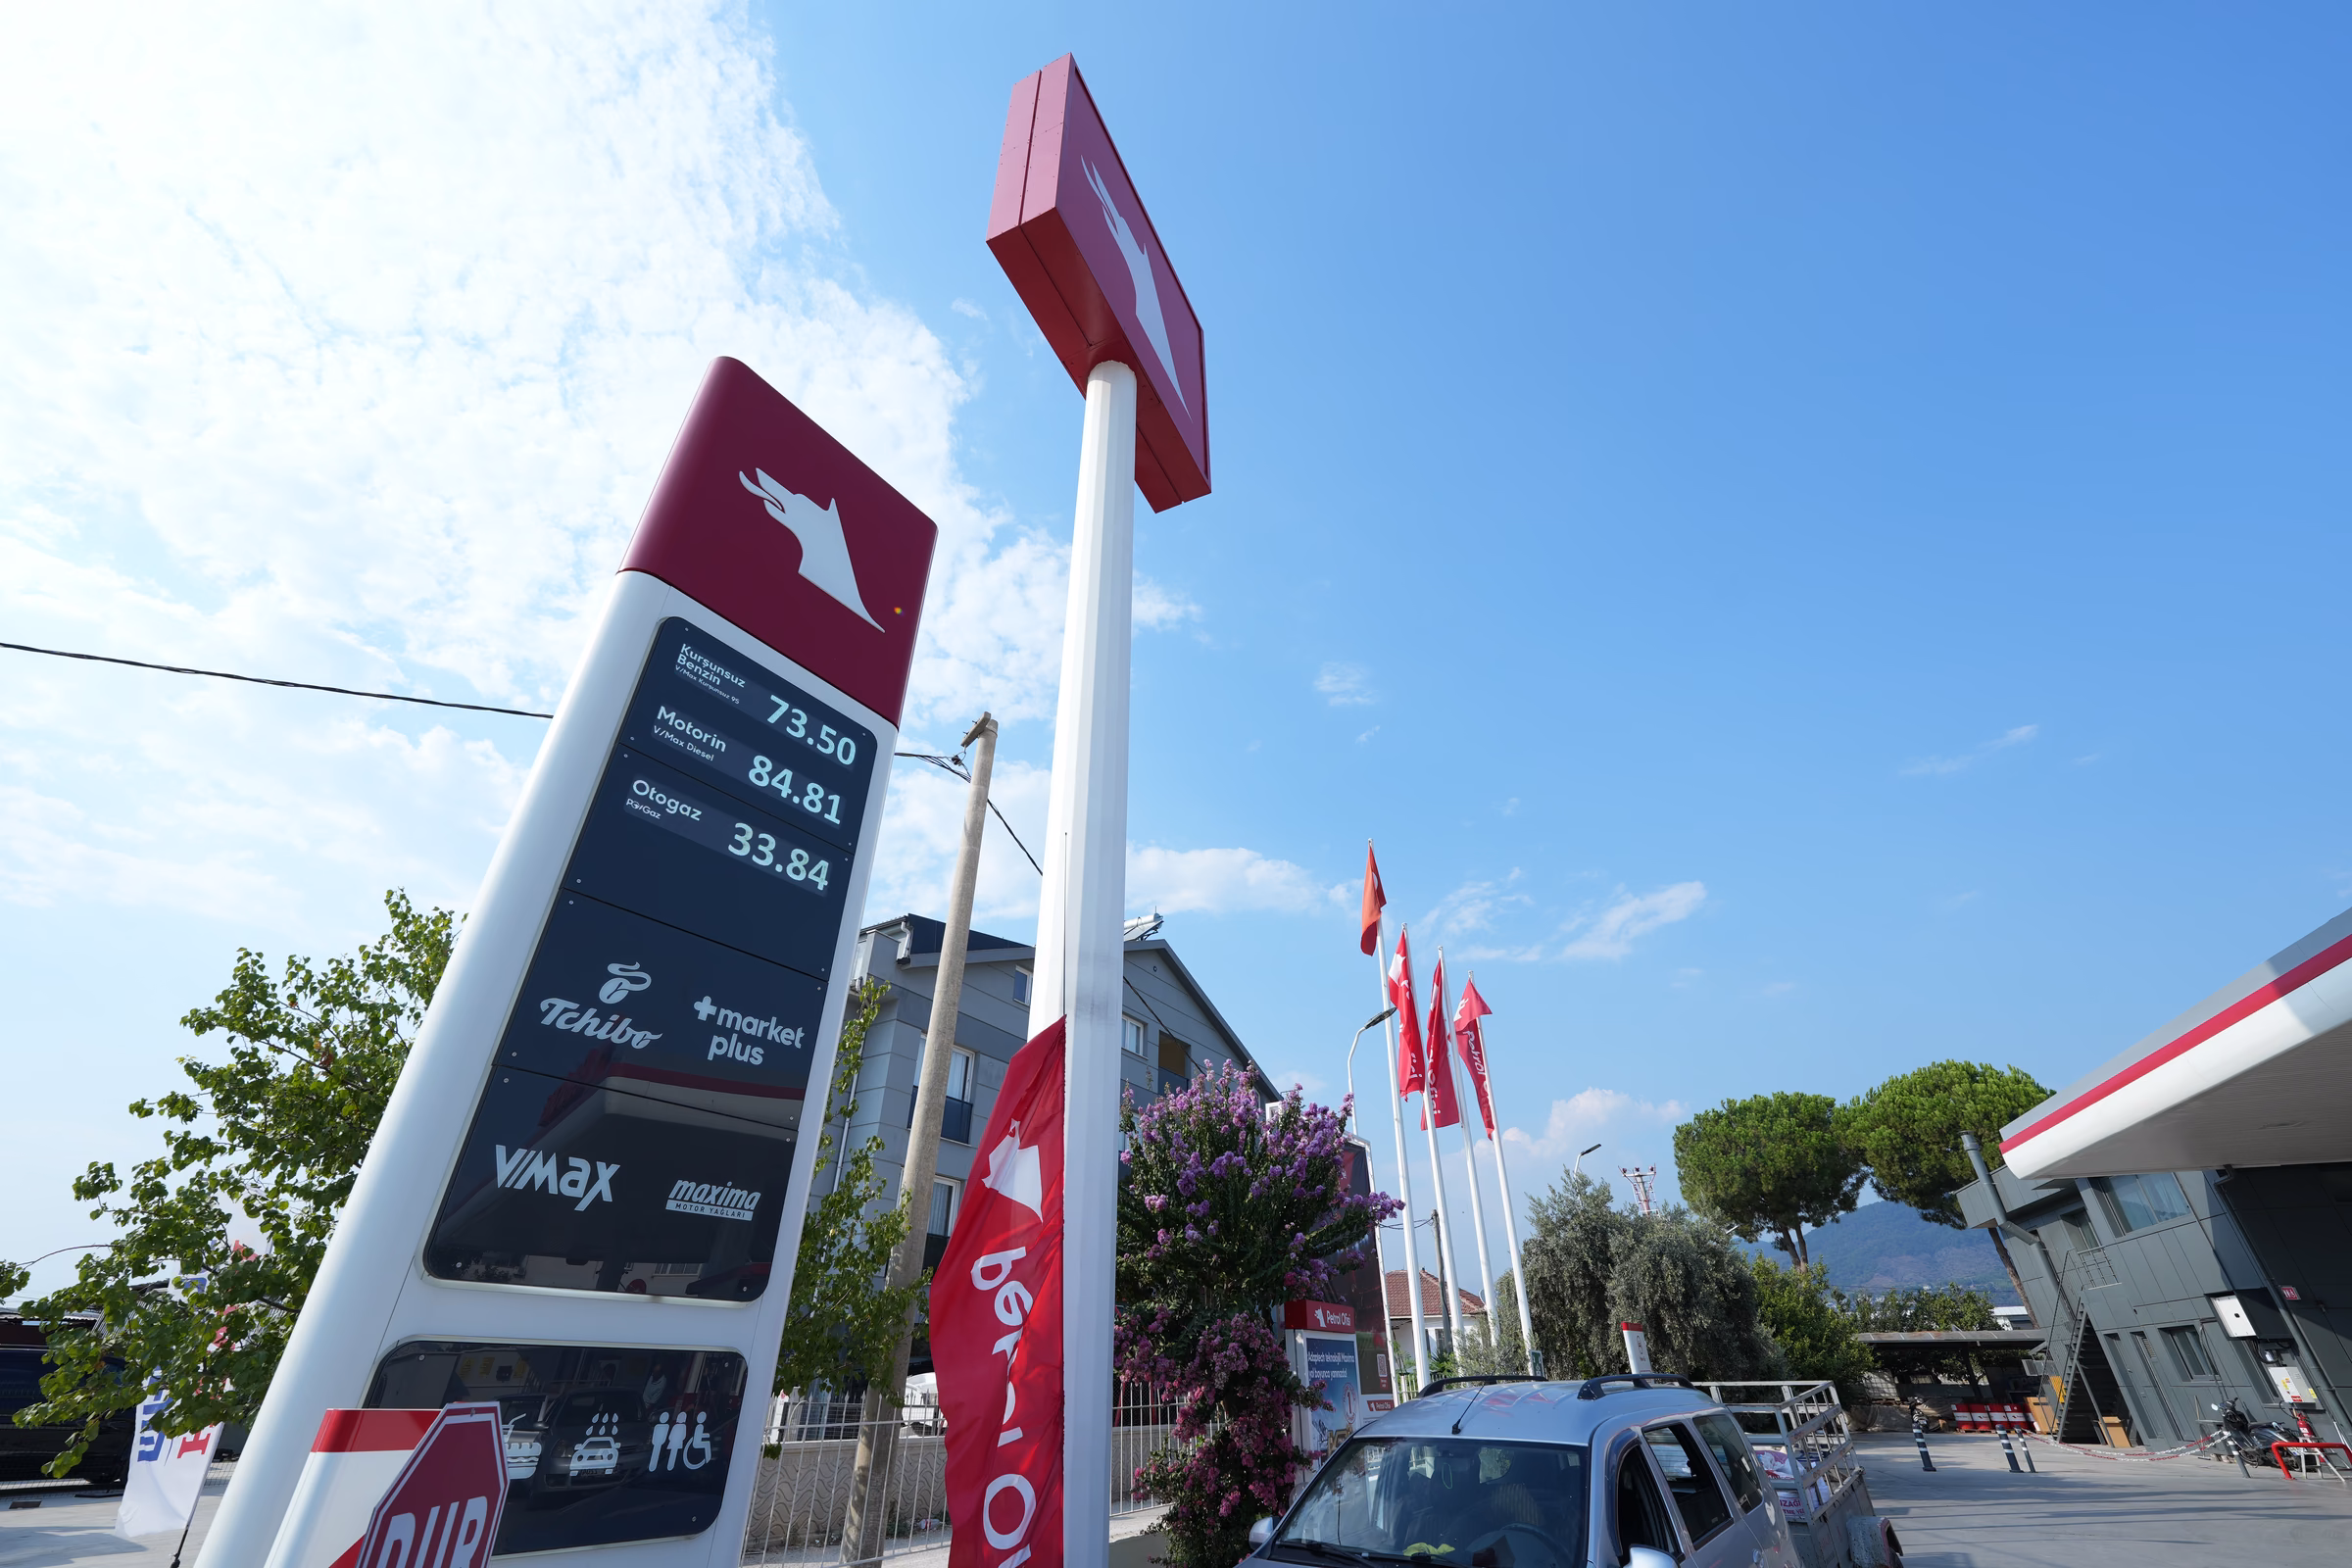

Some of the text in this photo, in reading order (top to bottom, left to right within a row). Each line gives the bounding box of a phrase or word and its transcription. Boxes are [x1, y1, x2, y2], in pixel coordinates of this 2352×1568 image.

[675, 664, 697, 681] V/Max
[731, 696, 740, 705] 95
[676, 653, 720, 685] Benzin
[681, 643, 746, 688] Kurşunsuz
[654, 725, 714, 761] V/Max Diesel
[657, 706, 726, 753] Motorin
[767, 694, 857, 765] 73.50
[632, 779, 703, 821] Otogaz
[748, 755, 841, 825] 84.81
[727, 822, 829, 891] 33.84
[540, 997, 662, 1050] Tchibo
[707, 1034, 764, 1066] plus
[668, 1179, 761, 1210] maxima
[674, 1202, 746, 1218] MOTOR YAĞLARI
[1327, 1310, 1351, 1326] Petrol Ofisi
